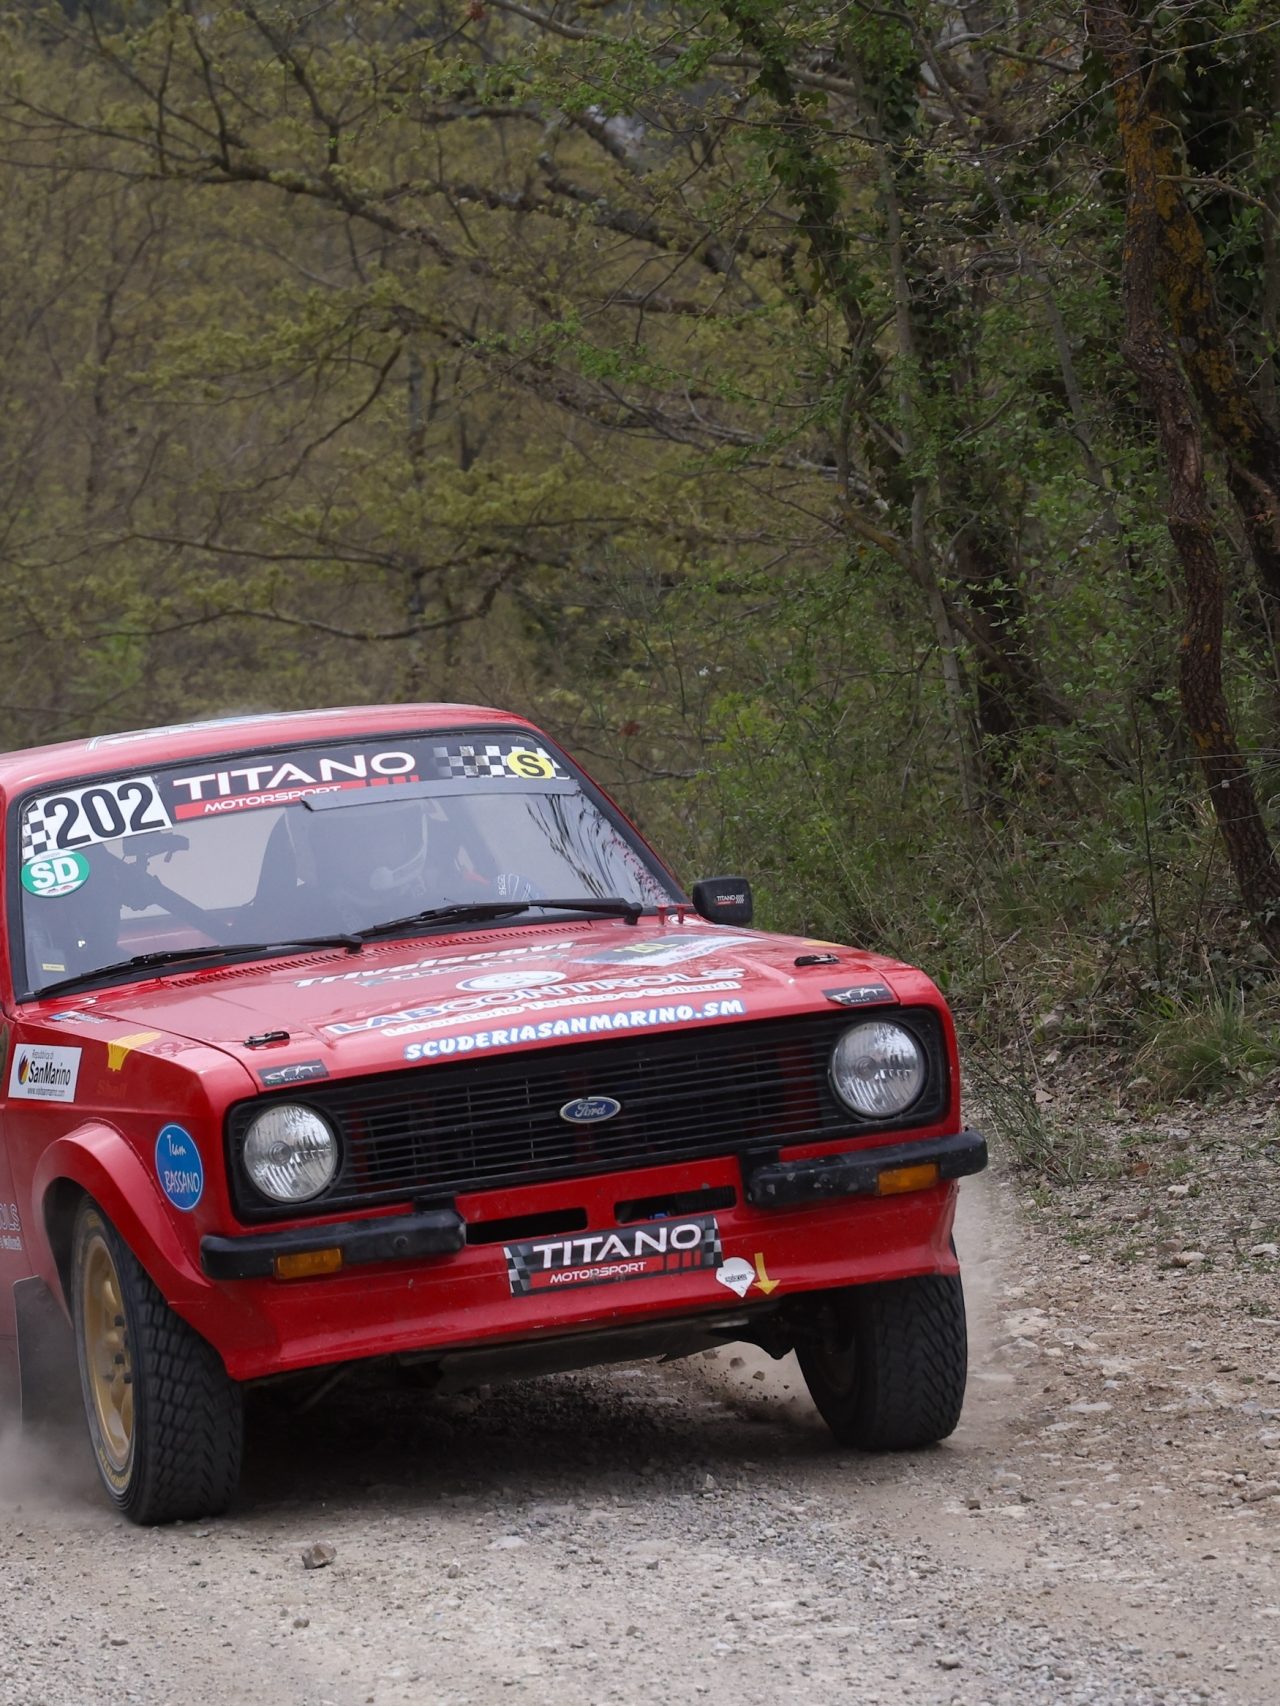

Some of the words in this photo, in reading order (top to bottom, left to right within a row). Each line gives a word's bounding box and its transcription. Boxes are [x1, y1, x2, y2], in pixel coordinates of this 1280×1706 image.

[173, 752, 416, 800] TITANO
[516, 754, 545, 777] S
[43, 782, 166, 849] 202
[30, 857, 79, 889] SD
[294, 942, 575, 988] Trivelscavi
[324, 968, 746, 1036] LABCONTROLS
[404, 999, 746, 1061] SCUDERIASANMARINO.SM
[28, 1060, 72, 1086] SanMarino
[575, 1102, 606, 1118] Ford
[164, 1170, 200, 1194] BASSANO
[532, 1223, 702, 1269] TITANO
[549, 1261, 647, 1284] MOTORSPORT
